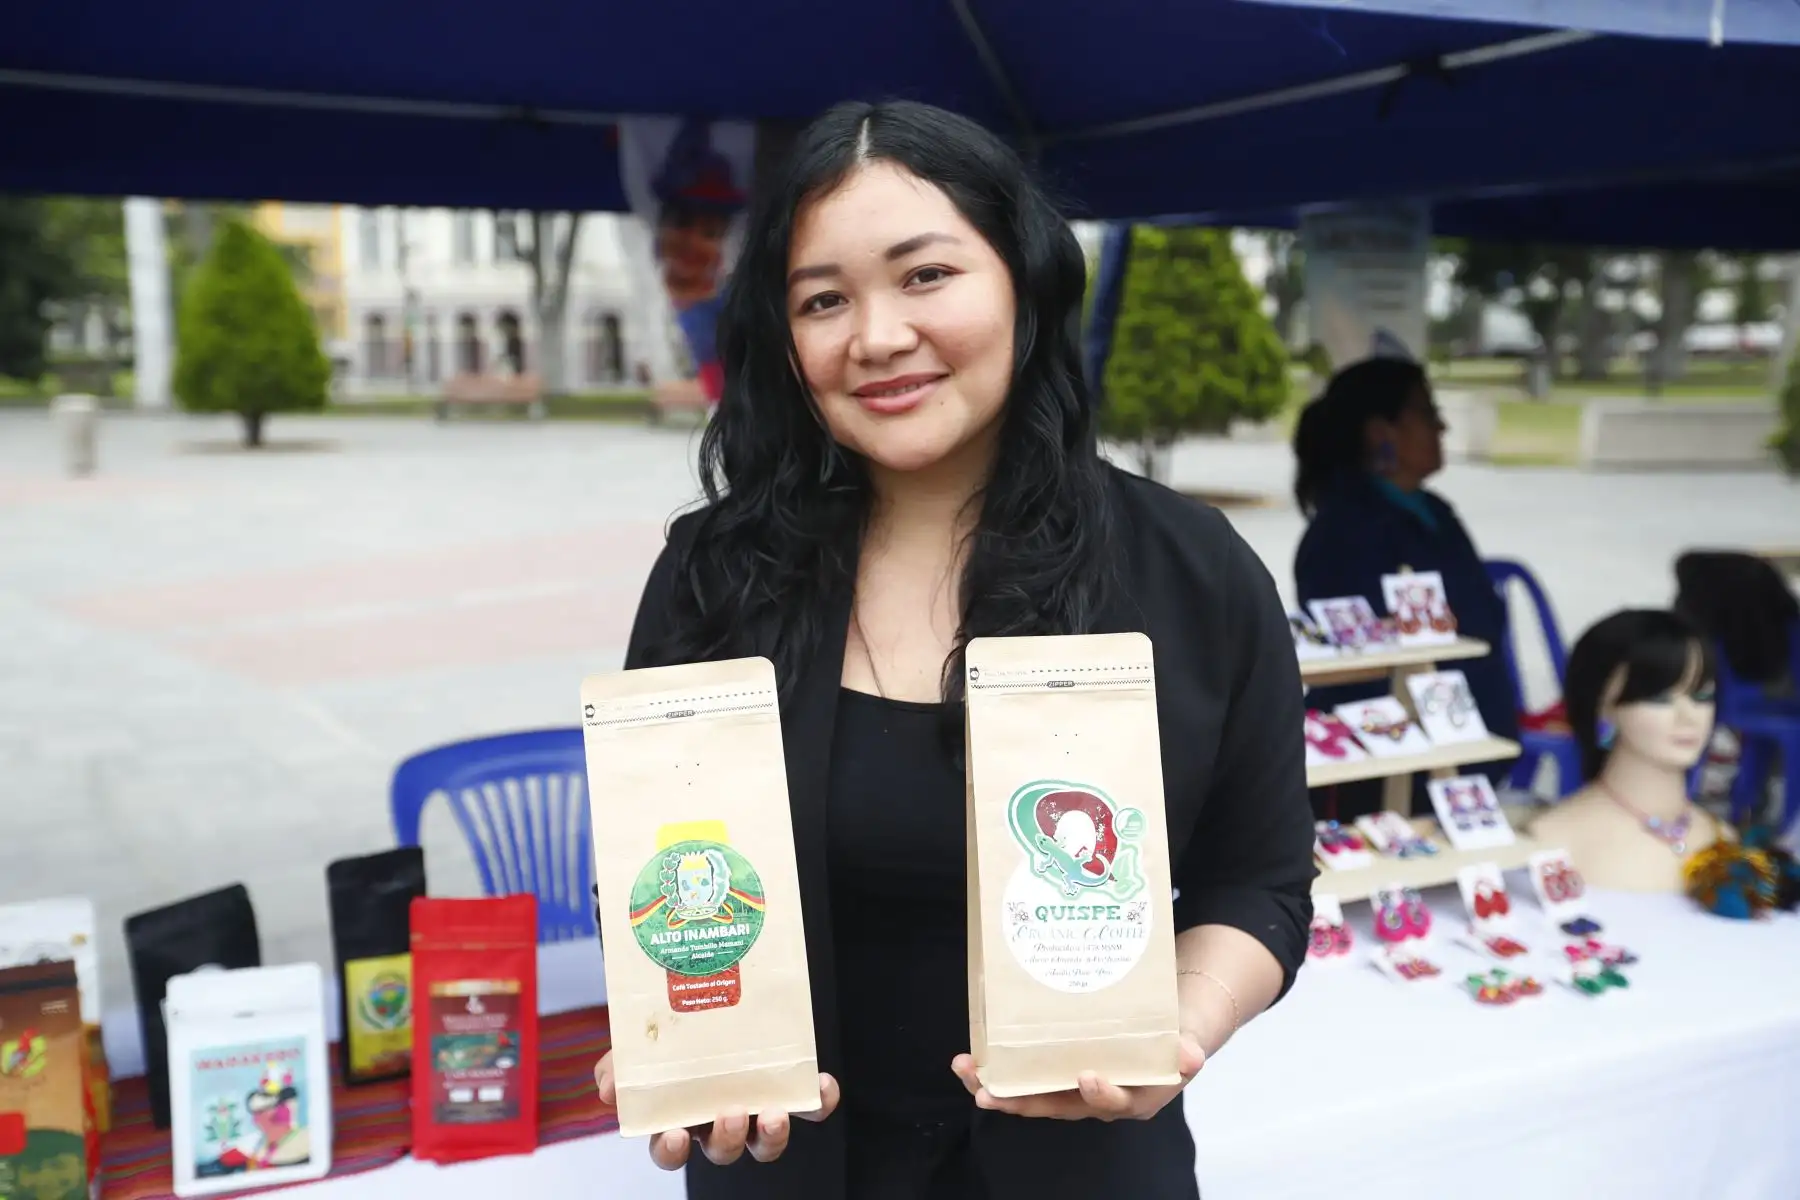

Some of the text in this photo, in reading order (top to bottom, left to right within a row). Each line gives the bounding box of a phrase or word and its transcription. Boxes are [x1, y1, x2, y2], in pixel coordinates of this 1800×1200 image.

[668, 710, 694, 719] ZIPPER
[1035, 905, 1121, 923] QUISPE
[650, 923, 750, 945] ALTO INAMBARI
[660, 945, 690, 954] Armando
[719, 940, 744, 948] Mamani
[691, 951, 715, 960] Alcalde
[672, 983, 686, 992] Café
[686, 981, 710, 991] Tostado
[716, 979, 736, 988] Origen
[682, 998, 696, 1007] Peso
[696, 997, 711, 1005] Neto:
